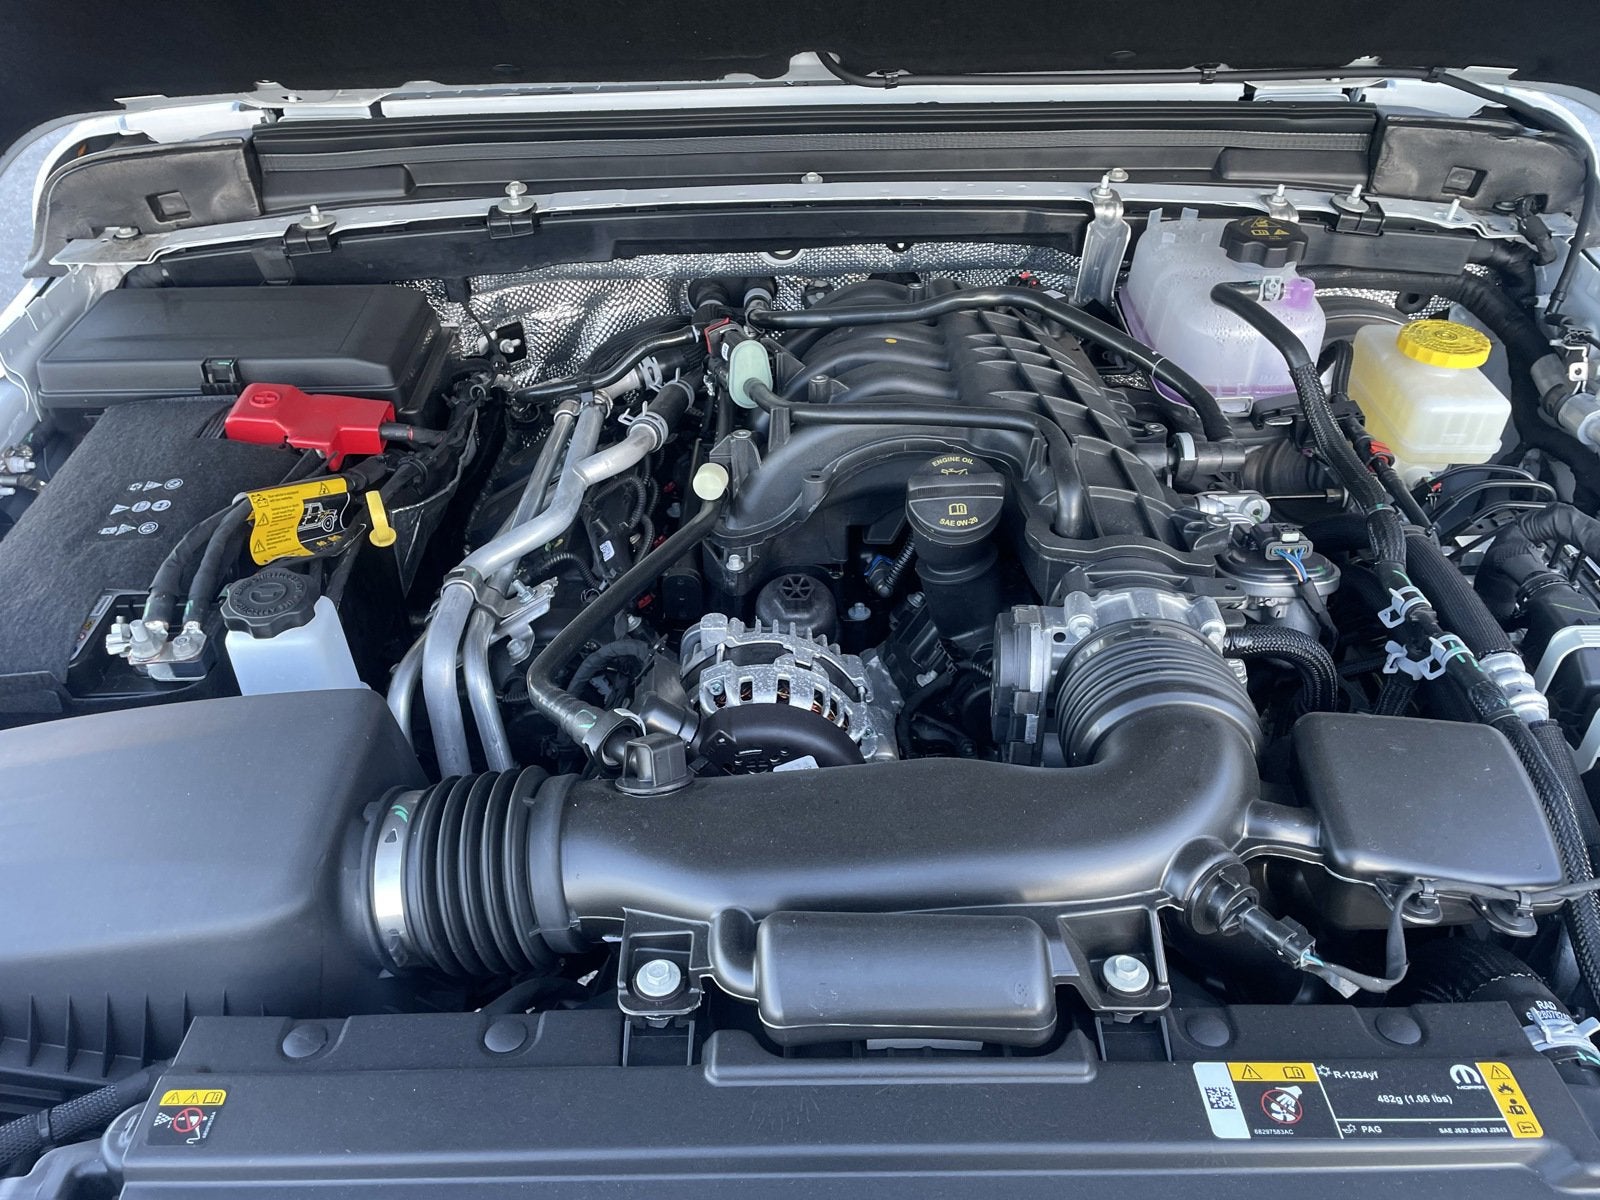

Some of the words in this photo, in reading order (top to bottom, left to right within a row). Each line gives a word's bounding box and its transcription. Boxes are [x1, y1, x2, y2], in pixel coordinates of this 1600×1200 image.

[931, 456, 961, 467] ENGINE
[961, 457, 975, 465] OIL
[939, 518, 956, 527] SAE
[956, 516, 979, 527] 0W-20
[1535, 1000, 1557, 1011] RAD
[1332, 1070, 1379, 1081] R-1234yf
[1377, 1094, 1404, 1105] 482g
[1404, 1094, 1431, 1105] (1.06
[1431, 1094, 1453, 1105] lbs)
[1360, 1125, 1383, 1133] PAG
